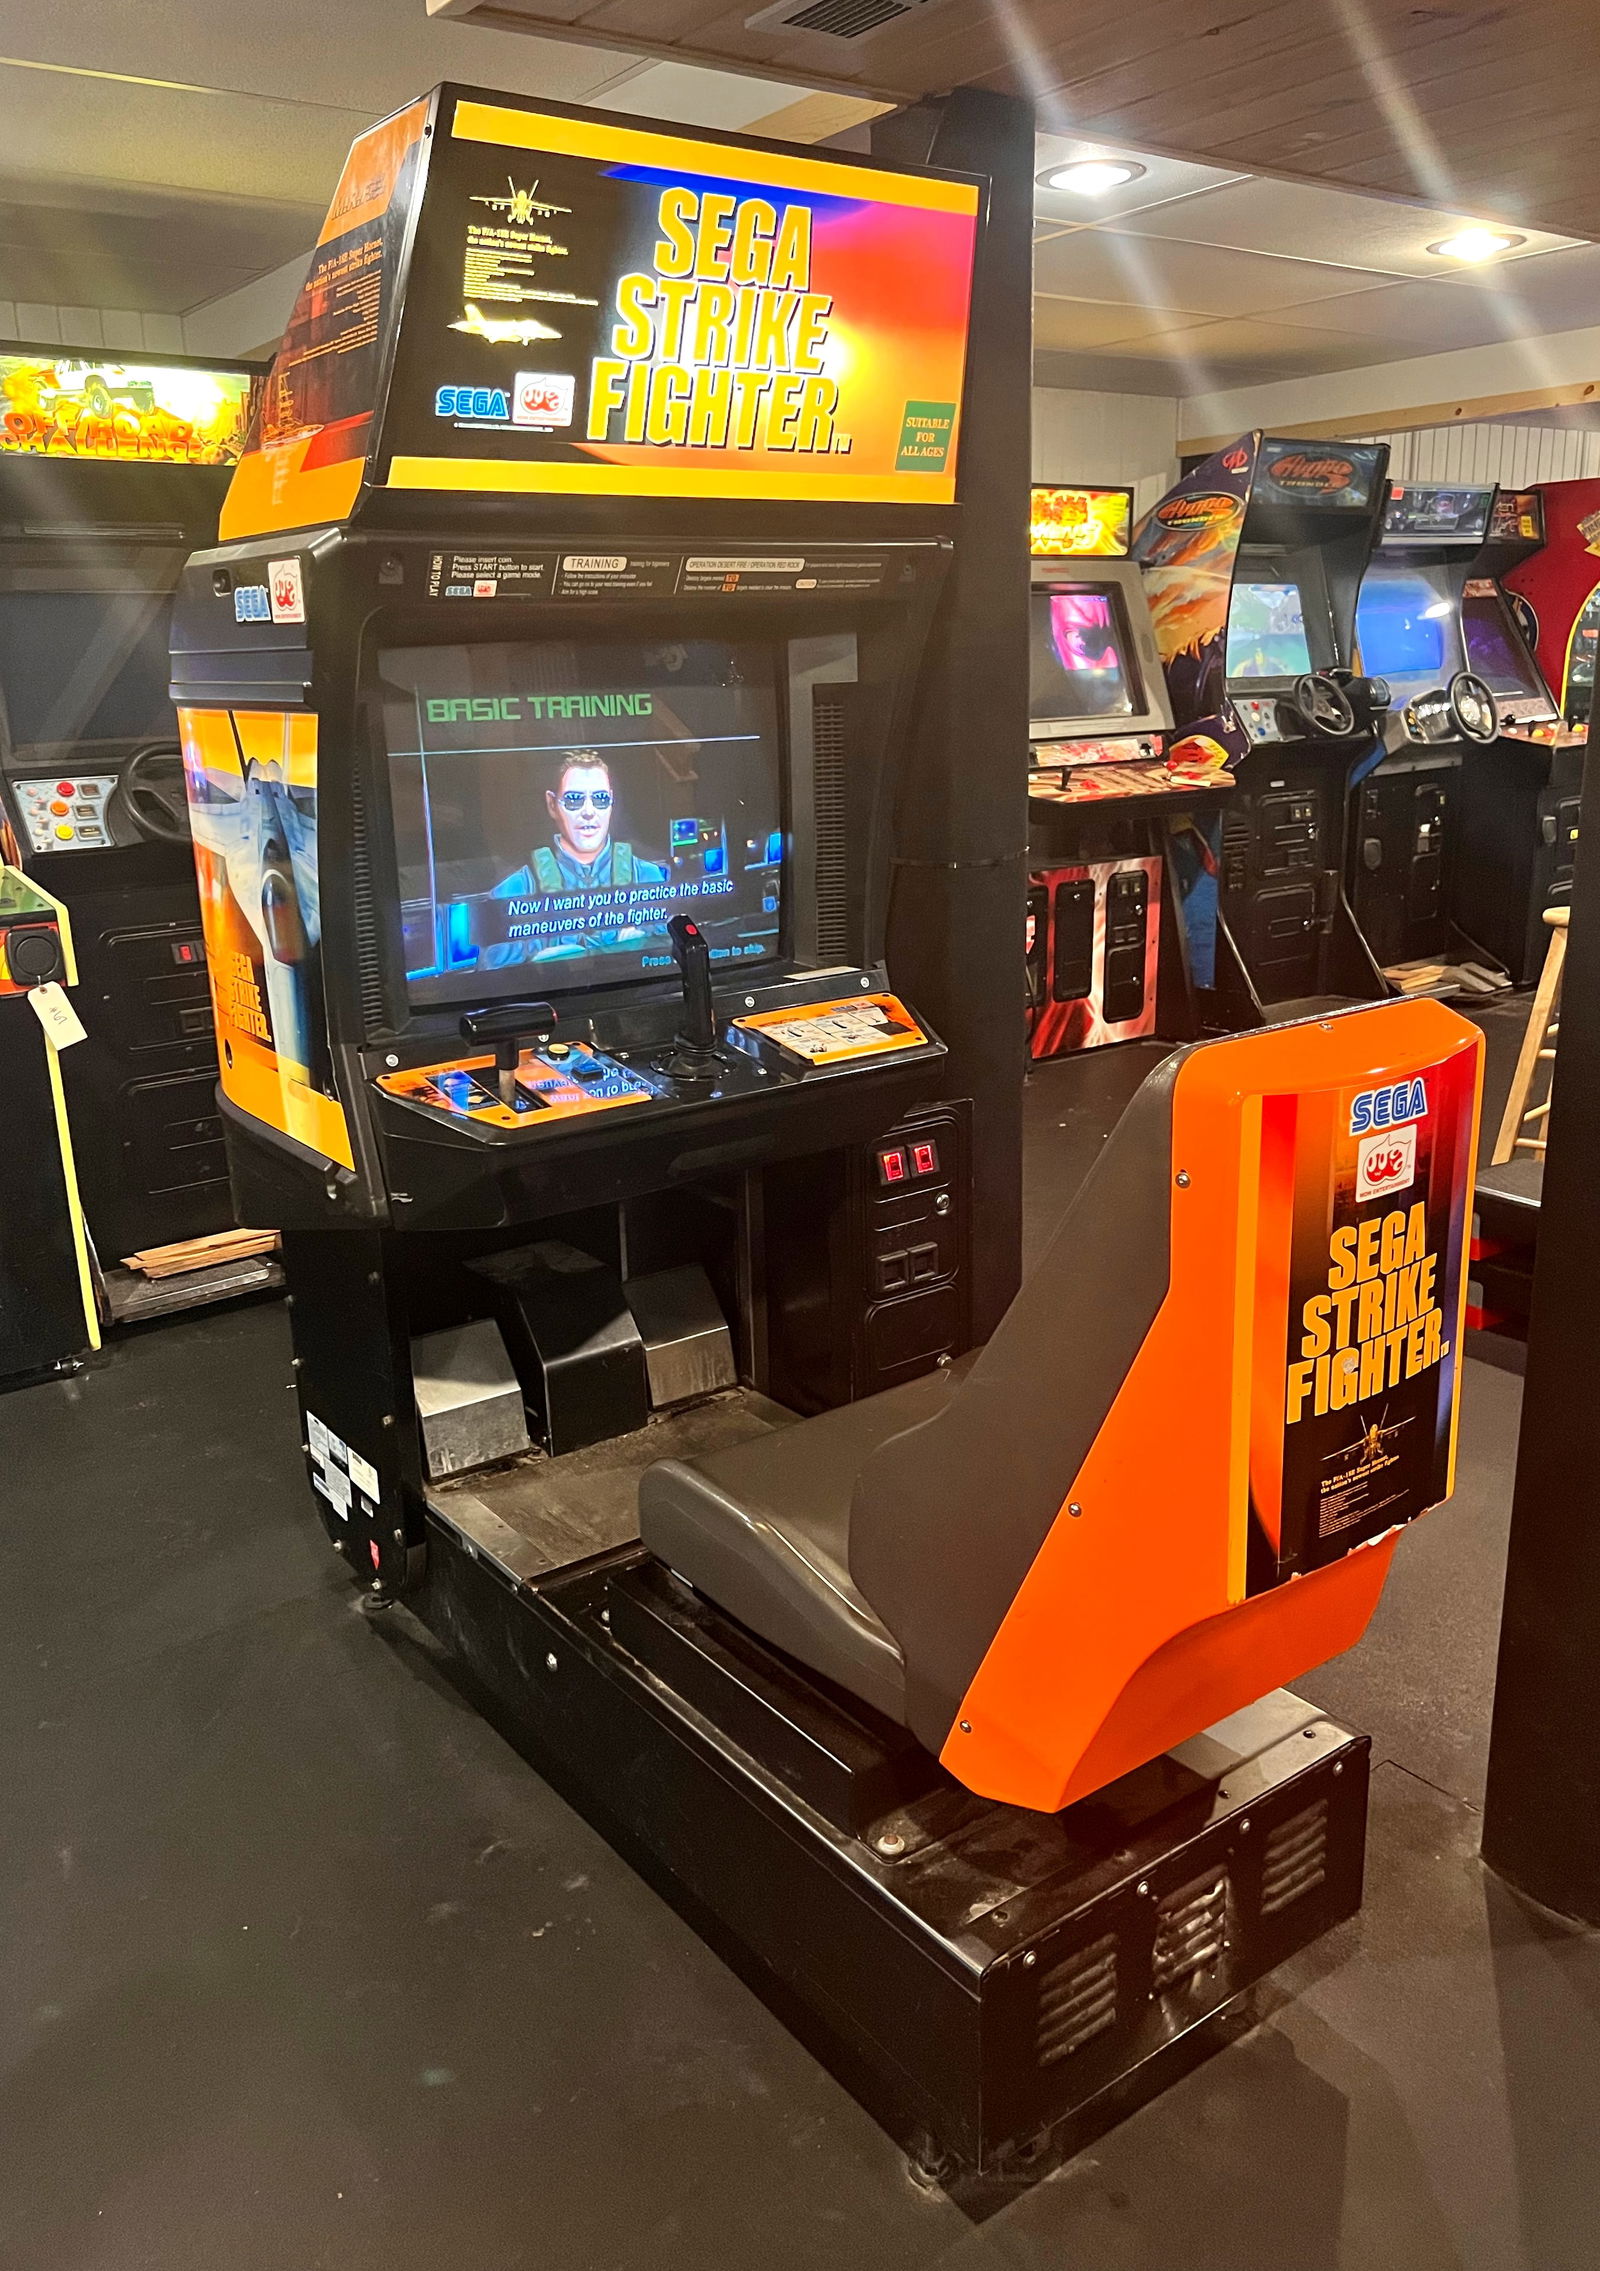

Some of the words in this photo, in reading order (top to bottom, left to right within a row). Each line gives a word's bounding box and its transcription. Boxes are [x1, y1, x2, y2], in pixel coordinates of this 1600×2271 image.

[653, 186, 812, 292] SEGA
[611, 272, 833, 375] STRIKE
[436, 385, 509, 420] SEGA
[906, 416, 950, 430] SUITABLE
[916, 432, 935, 443] FOR
[0, 430, 201, 463] CHALLENGE
[901, 446, 920, 456] ALL
[920, 446, 944, 458] AGES
[431, 570, 441, 580] TO
[432, 556, 443, 570] HOW
[571, 558, 619, 568] TRAINING
[429, 581, 440, 597] PLAY
[445, 586, 472, 596] SEGA
[235, 586, 271, 622] SEGA
[426, 698, 521, 722] BASIC
[527, 694, 652, 719] TRAINING
[508, 900, 541, 916] Now
[544, 897, 550, 912] I
[552, 894, 584, 911] want
[588, 893, 611, 910] you
[614, 890, 627, 905] to
[629, 884, 677, 906] practice
[680, 882, 699, 897] the
[701, 879, 734, 895] basic
[508, 919, 585, 938] maneuvers
[588, 912, 602, 928] of
[604, 910, 624, 925] the
[627, 907, 668, 925] fighter.
[642, 956, 672, 968] Press
[732, 946, 742, 956] to
[1349, 1077, 1428, 1136] SEGA
[1328, 1200, 1426, 1290] SEGA
[1301, 1252, 1438, 1358] STRIKE
